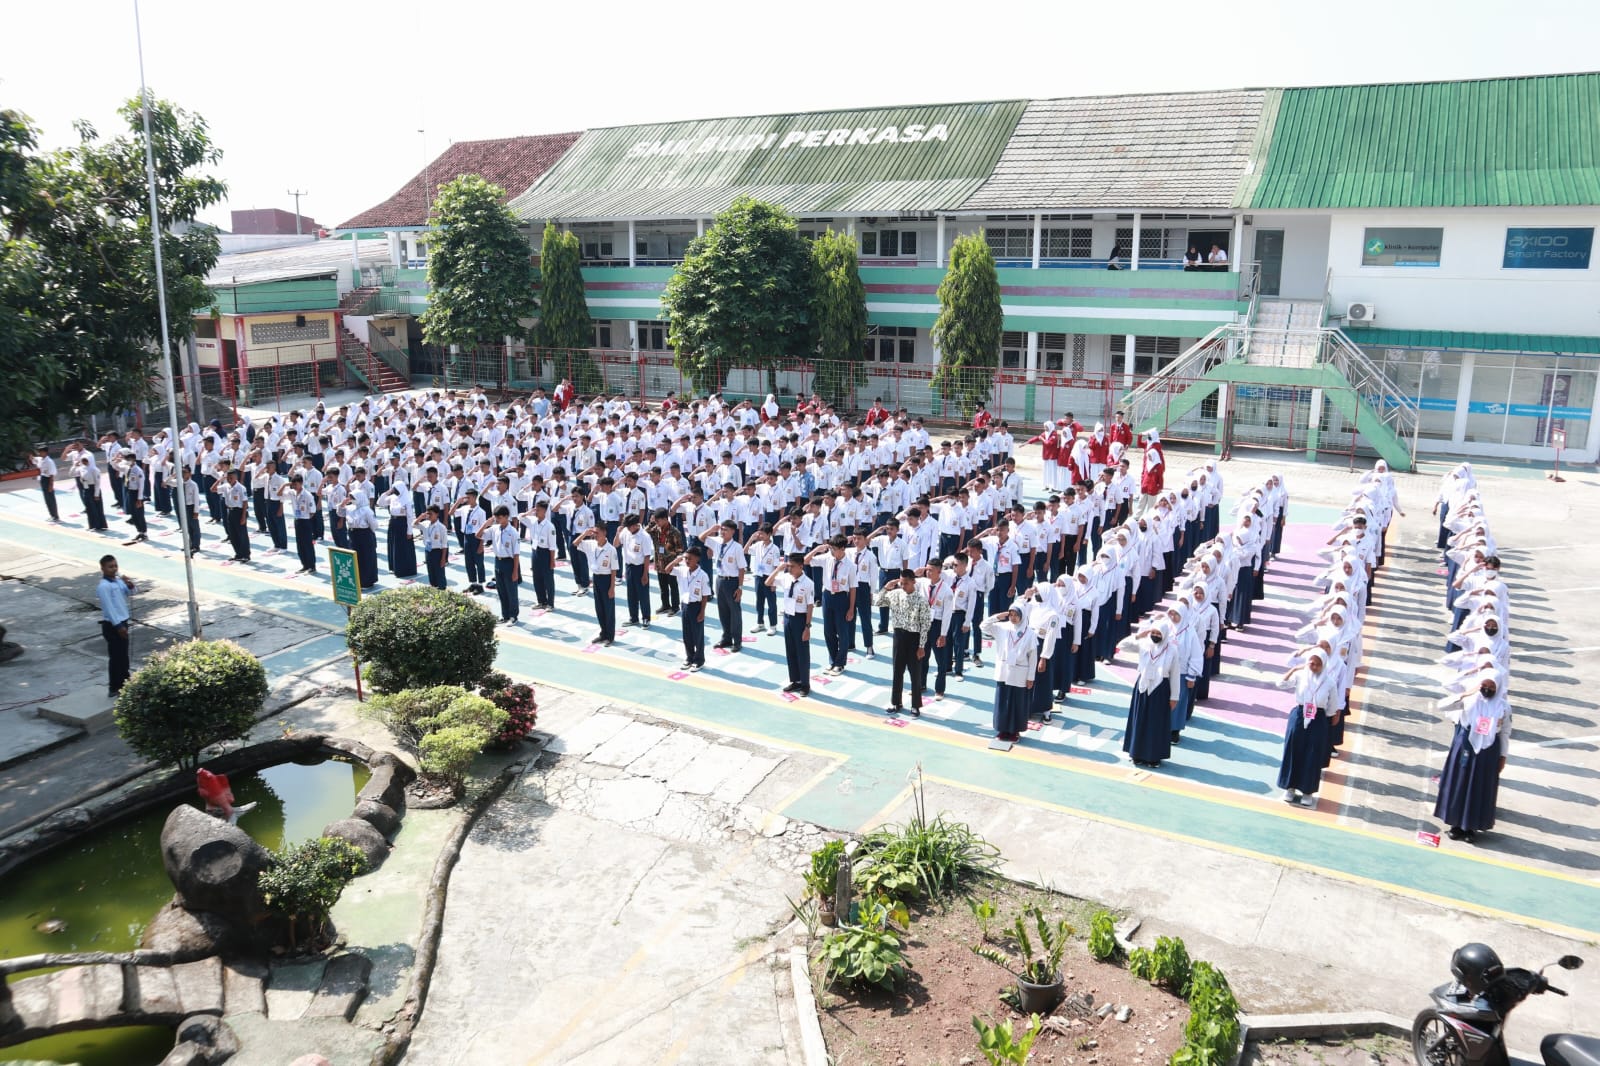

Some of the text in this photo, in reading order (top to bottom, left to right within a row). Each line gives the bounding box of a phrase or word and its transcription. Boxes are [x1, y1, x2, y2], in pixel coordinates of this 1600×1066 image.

[778, 123, 949, 149] PERKASA
[1507, 250, 1587, 259] Smart Factory
